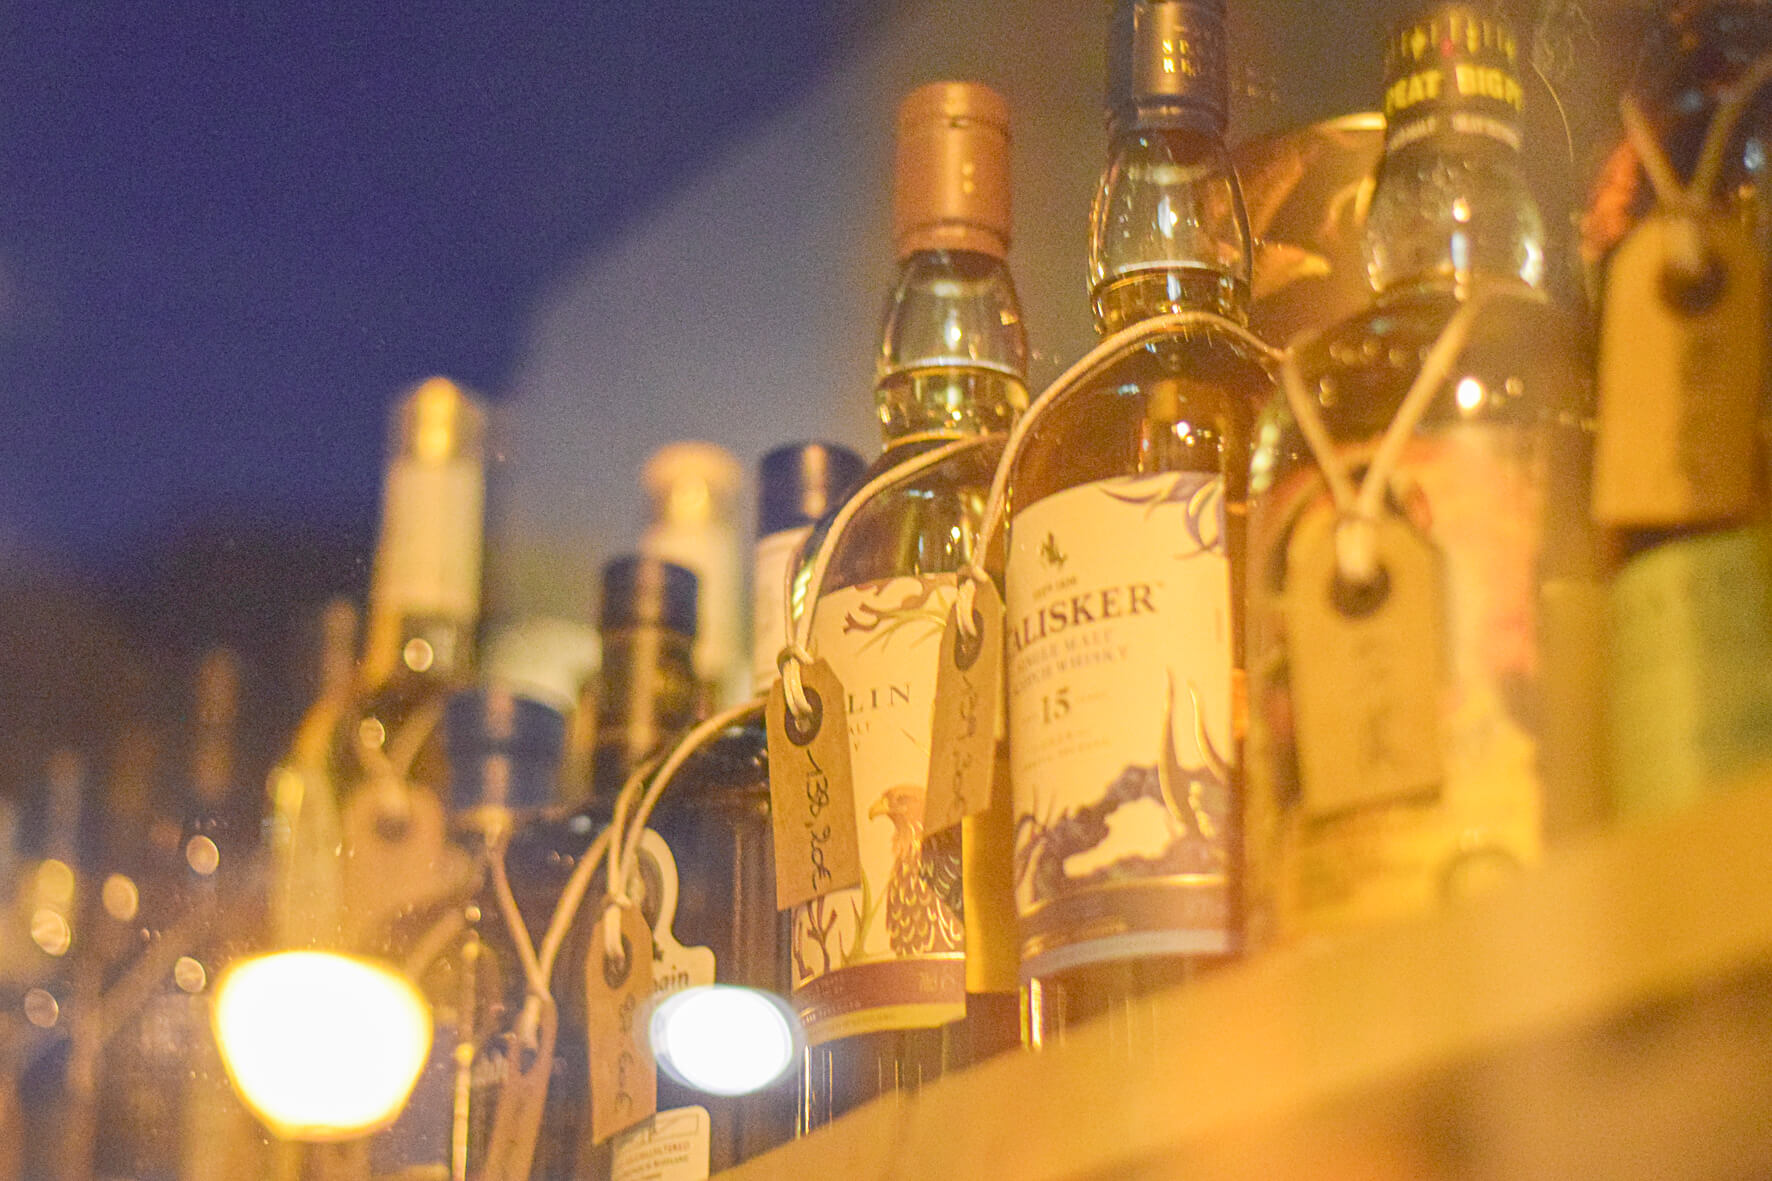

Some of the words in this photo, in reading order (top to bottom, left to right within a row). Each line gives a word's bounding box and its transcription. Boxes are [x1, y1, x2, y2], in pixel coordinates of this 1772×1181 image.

[1009, 582, 1157, 652] ALISKER
[848, 681, 912, 715] LIN
[1041, 685, 1071, 725] 15
